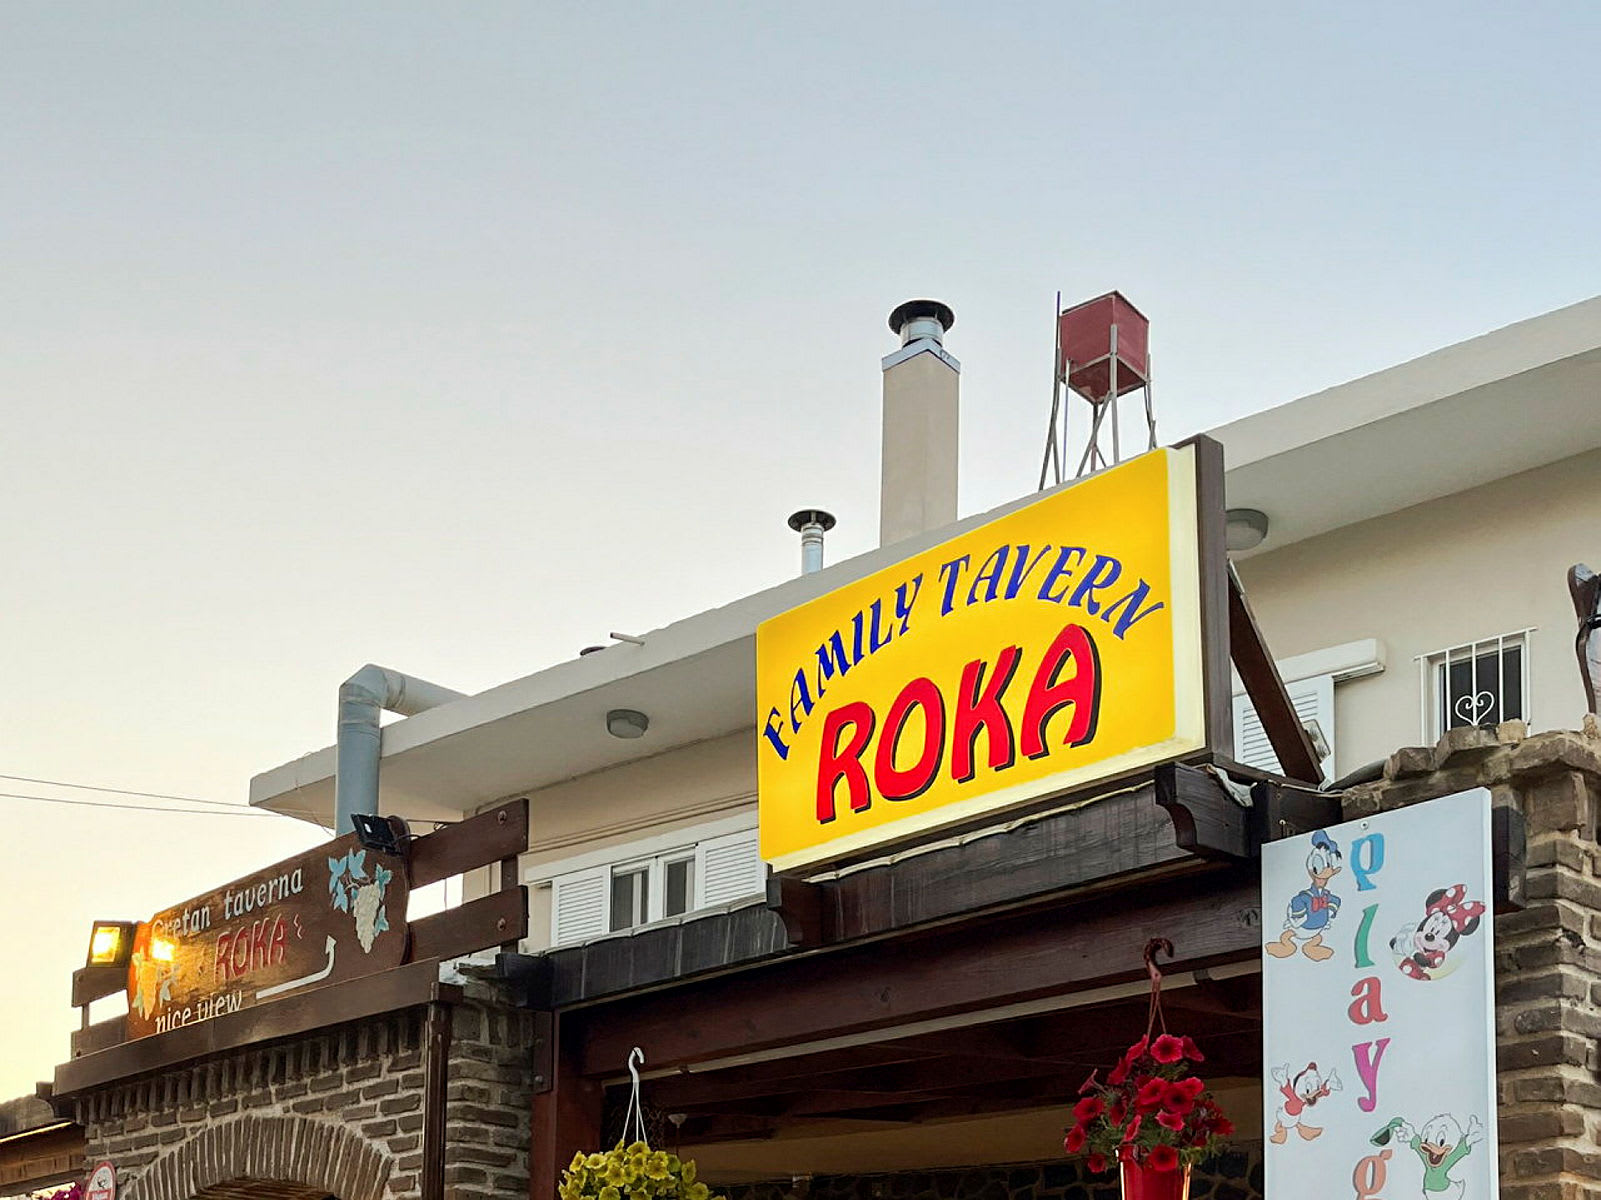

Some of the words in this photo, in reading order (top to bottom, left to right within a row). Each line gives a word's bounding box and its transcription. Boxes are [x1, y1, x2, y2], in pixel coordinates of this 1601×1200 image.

[763, 573, 923, 760] FAMILY
[939, 544, 1164, 641] TAVERN
[816, 623, 1102, 825] ROKA
[152, 905, 211, 937] Cretan
[224, 868, 303, 920] taverna
[214, 913, 288, 984] ROKA
[155, 1007, 191, 1034] nice
[197, 990, 242, 1022] view
